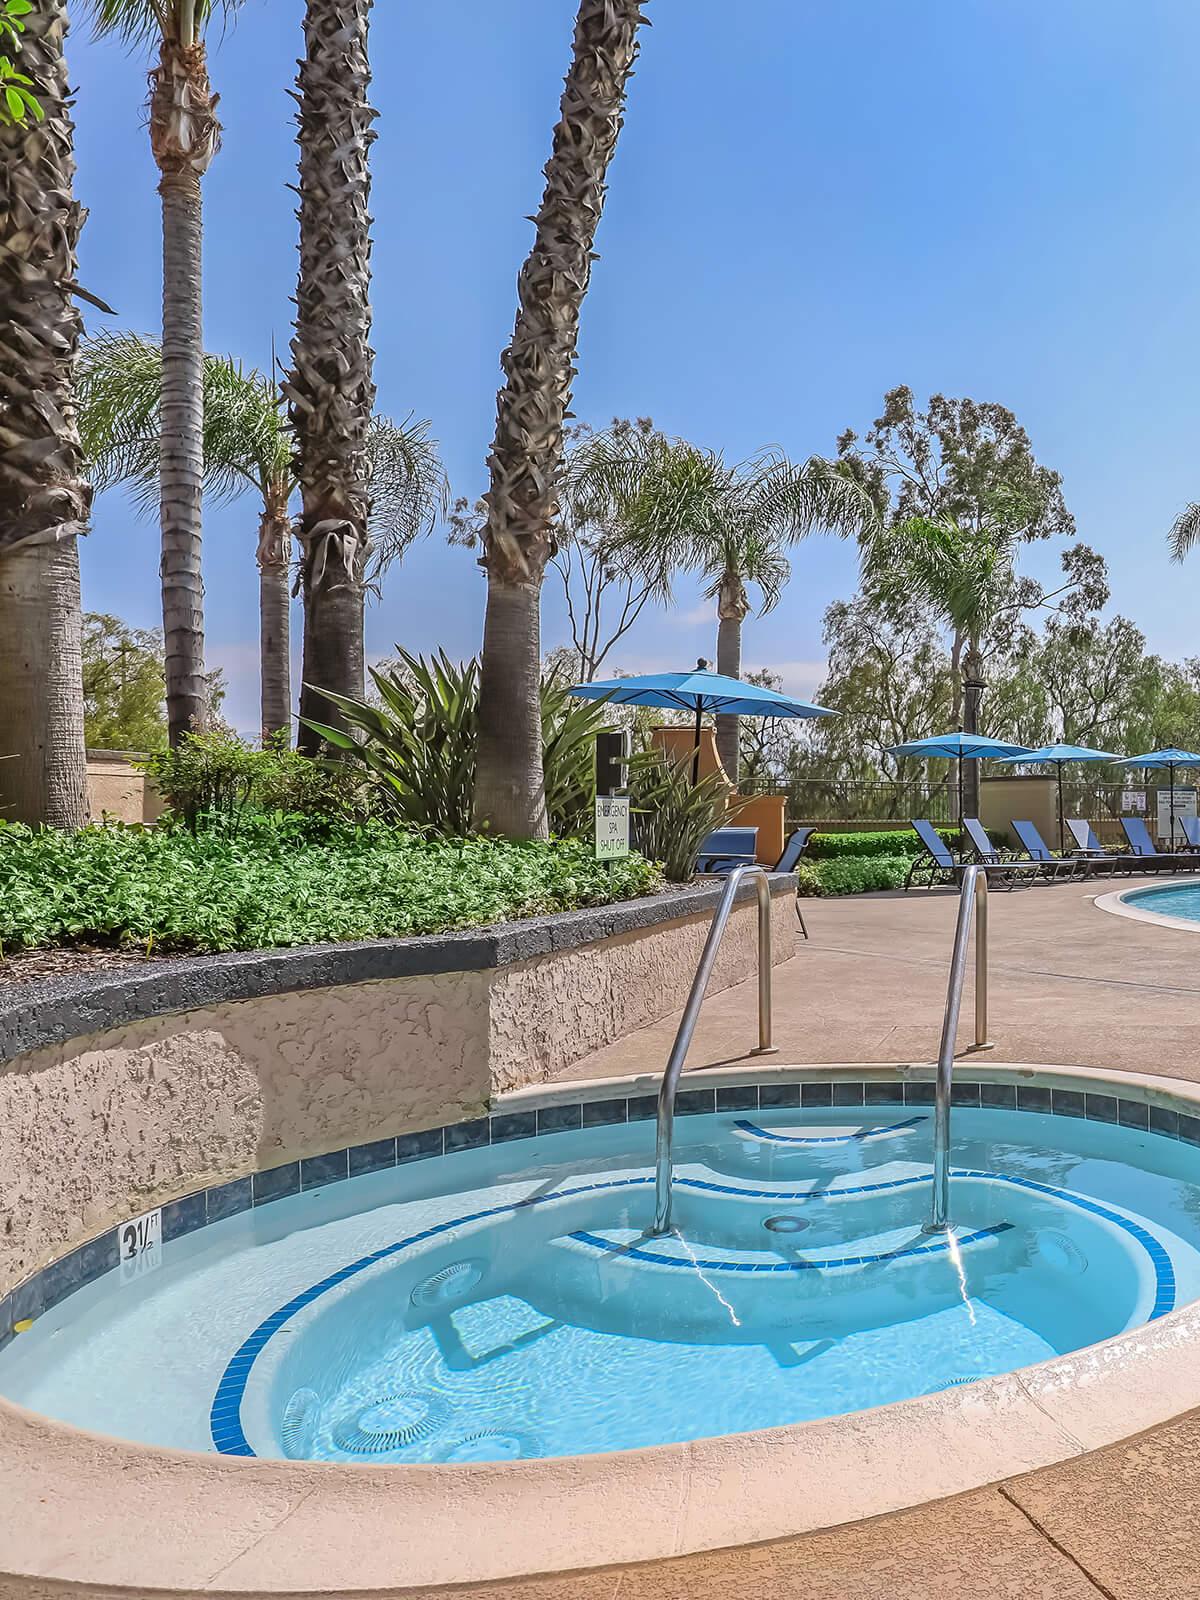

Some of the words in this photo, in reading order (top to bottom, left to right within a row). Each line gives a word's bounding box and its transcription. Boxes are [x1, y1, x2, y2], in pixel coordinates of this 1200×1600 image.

[597, 805, 628, 817] EMERGENCY
[608, 822, 619, 834] SPA
[600, 839, 615, 851] SHUT
[616, 838, 625, 850] OFF
